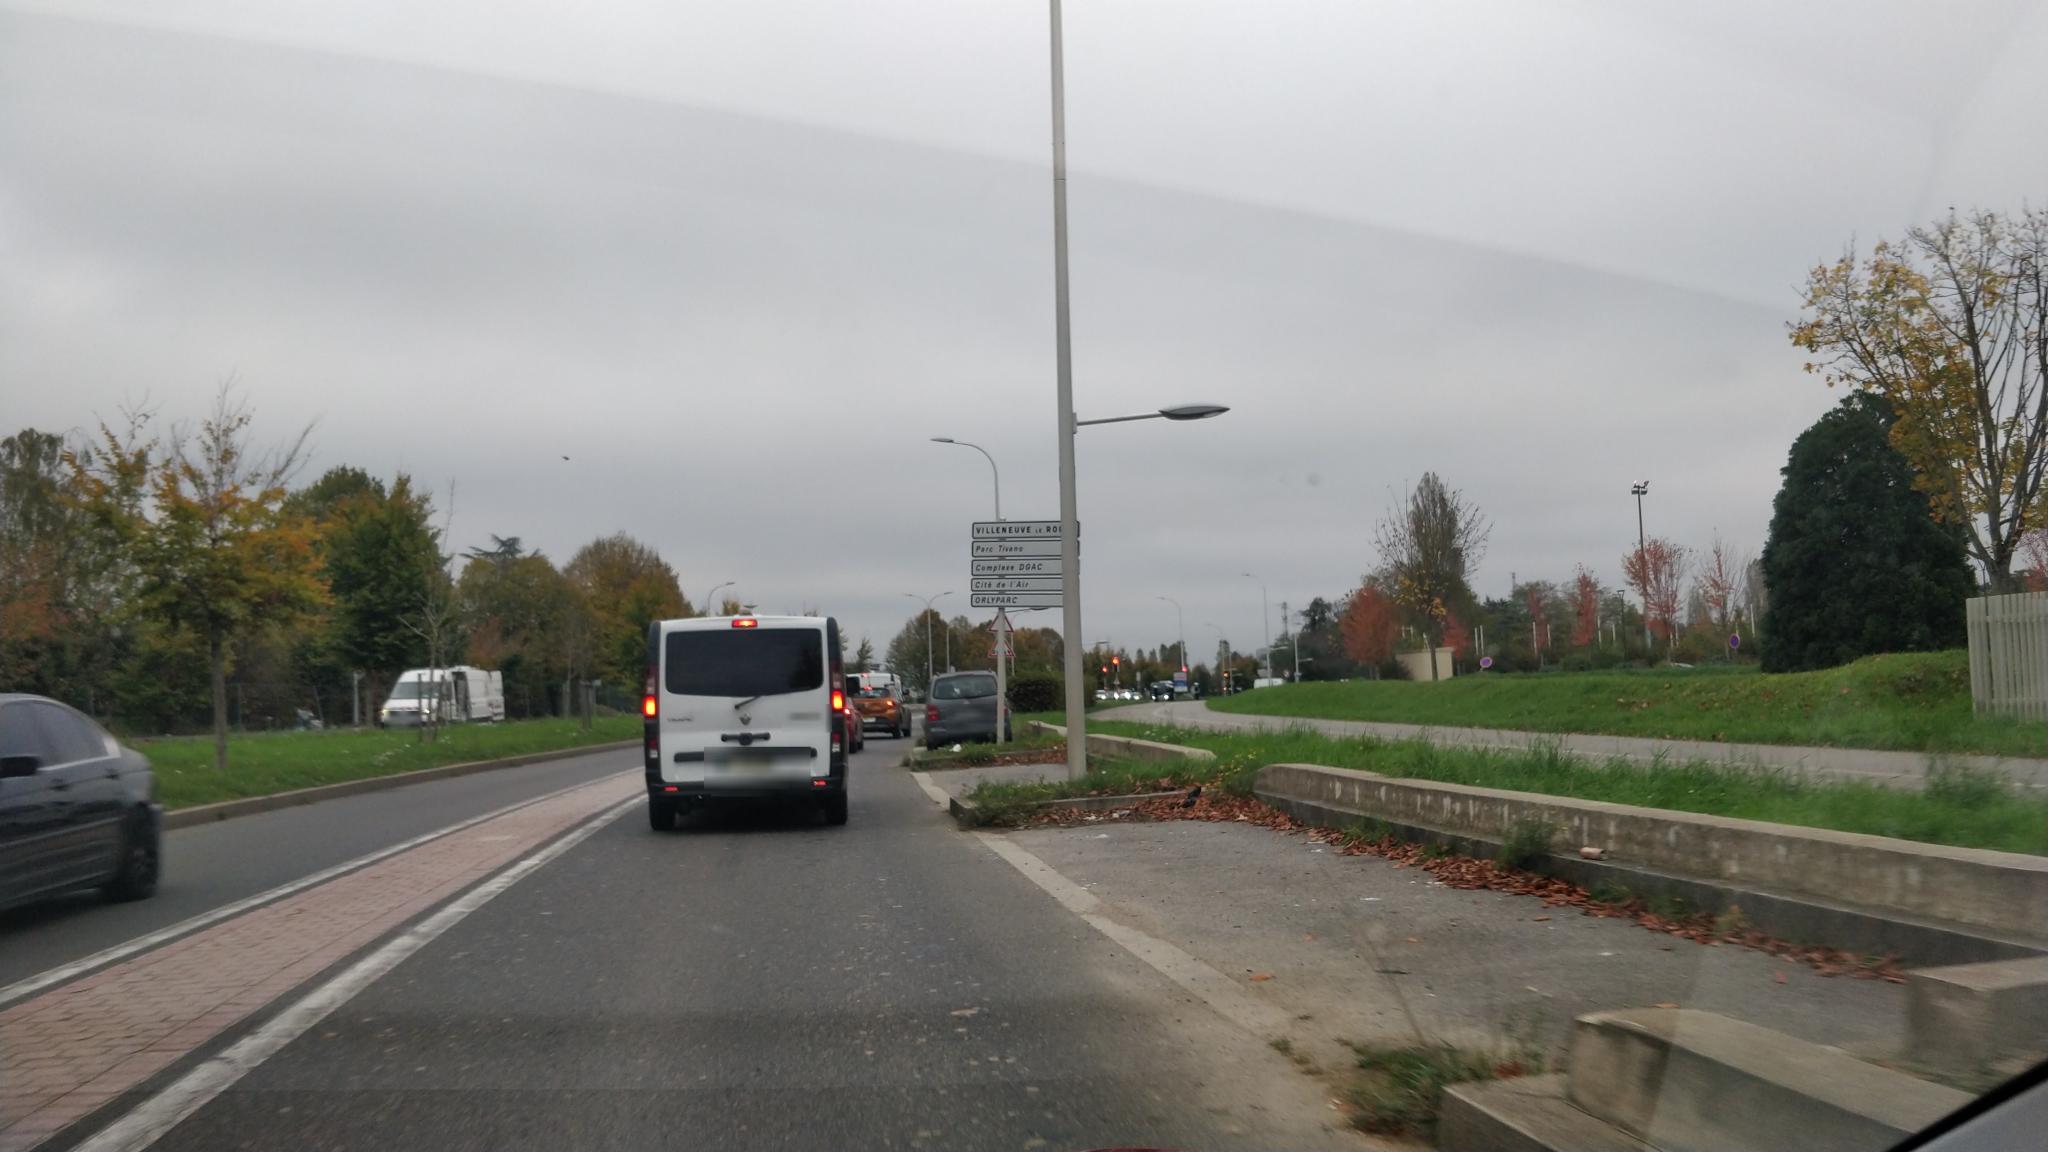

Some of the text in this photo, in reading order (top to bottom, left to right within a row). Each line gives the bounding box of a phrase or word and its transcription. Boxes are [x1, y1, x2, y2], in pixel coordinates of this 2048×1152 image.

[976, 526, 1031, 534] VILLENEUVE
[975, 545, 993, 553] Parc
[975, 564, 1014, 572] Complexe
[974, 596, 1018, 604] ORLYPARC
